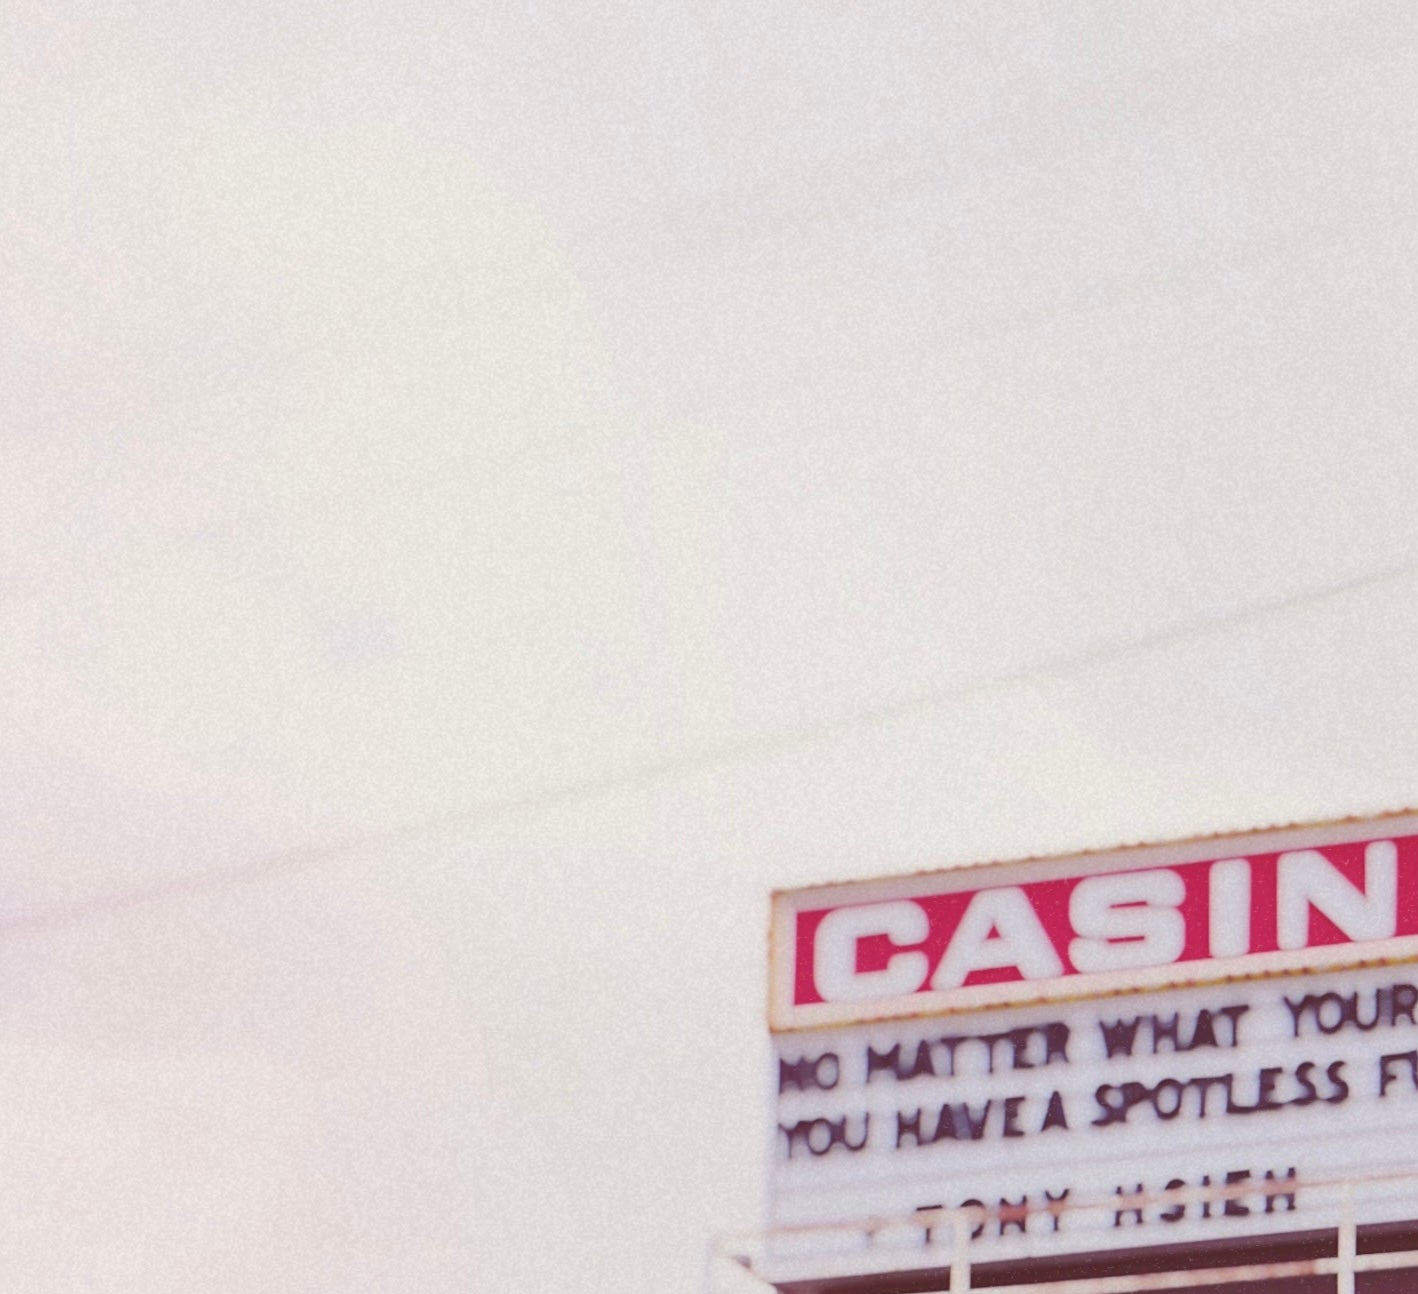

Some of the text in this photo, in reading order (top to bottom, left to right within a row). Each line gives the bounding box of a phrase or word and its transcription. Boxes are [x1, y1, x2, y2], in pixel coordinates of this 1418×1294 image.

[779, 1053, 840, 1094] NO
[866, 1022, 1070, 1084] MATTER
[1099, 1004, 1249, 1059] WHAT
[1283, 984, 1418, 1037] YOUR
[778, 1113, 869, 1158] YOU
[896, 1096, 1025, 1150] HAVE
[1041, 1091, 1069, 1132] A
[1092, 1061, 1349, 1126] SPOTLESS
[1114, 1166, 1297, 1228] HSIEH
